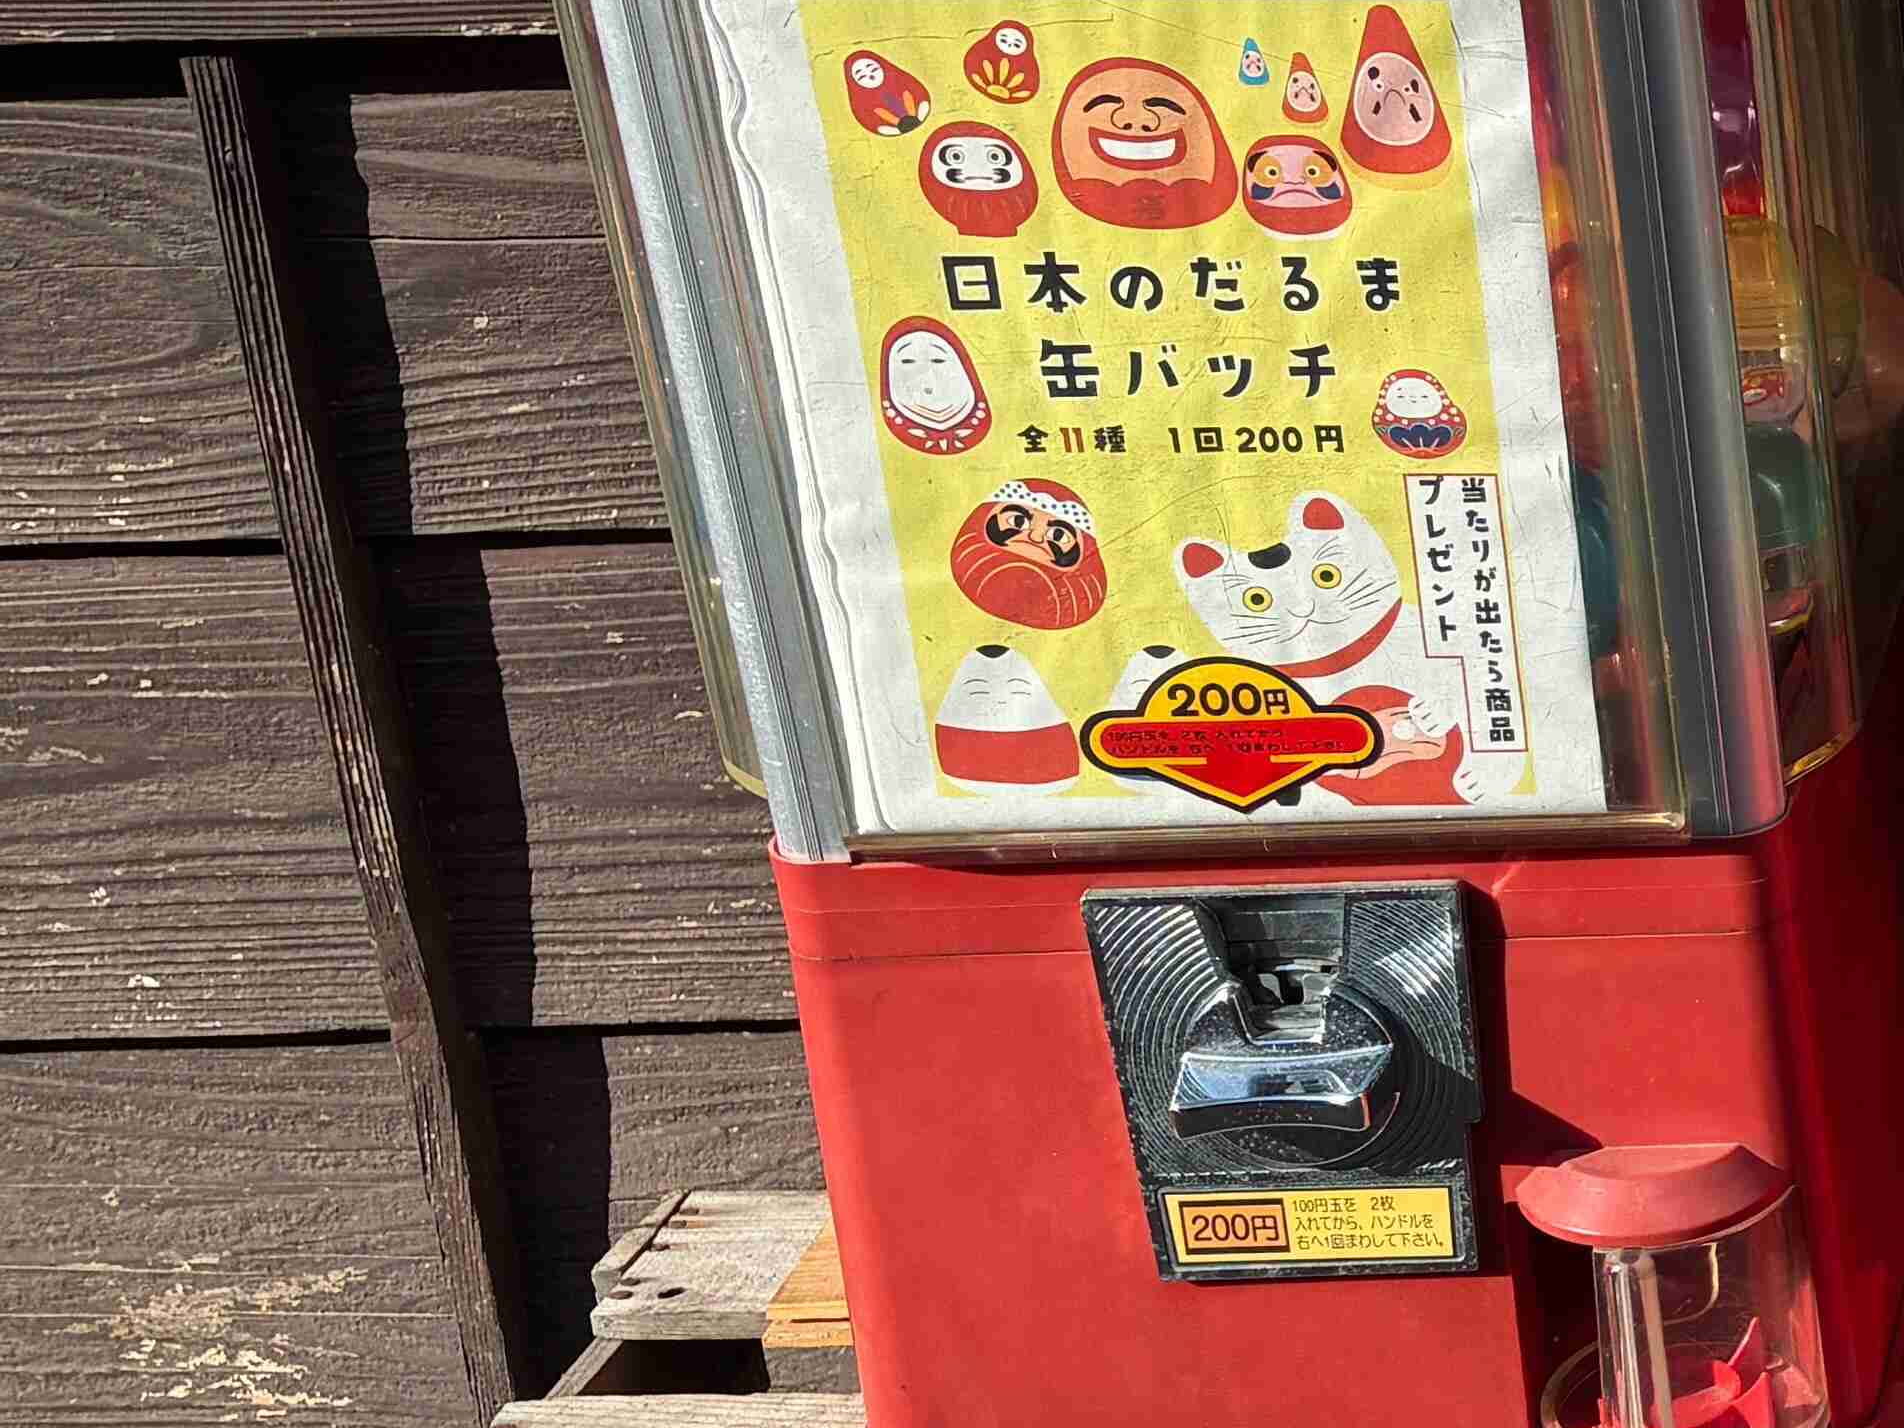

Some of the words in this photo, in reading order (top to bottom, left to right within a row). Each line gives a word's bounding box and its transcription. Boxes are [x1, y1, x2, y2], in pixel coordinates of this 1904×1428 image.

[941, 251, 1402, 314] 日本のだるま
[1039, 339, 1337, 401] 缶バッチ
[1017, 424, 1127, 453] 全11種
[1168, 424, 1345, 453] 1回200円
[1419, 476, 1457, 641] プレゼント
[1461, 477, 1515, 743] 当たりが出たら商品
[1167, 683, 1290, 716] 200円
[1191, 1214, 1280, 1243] 200円
